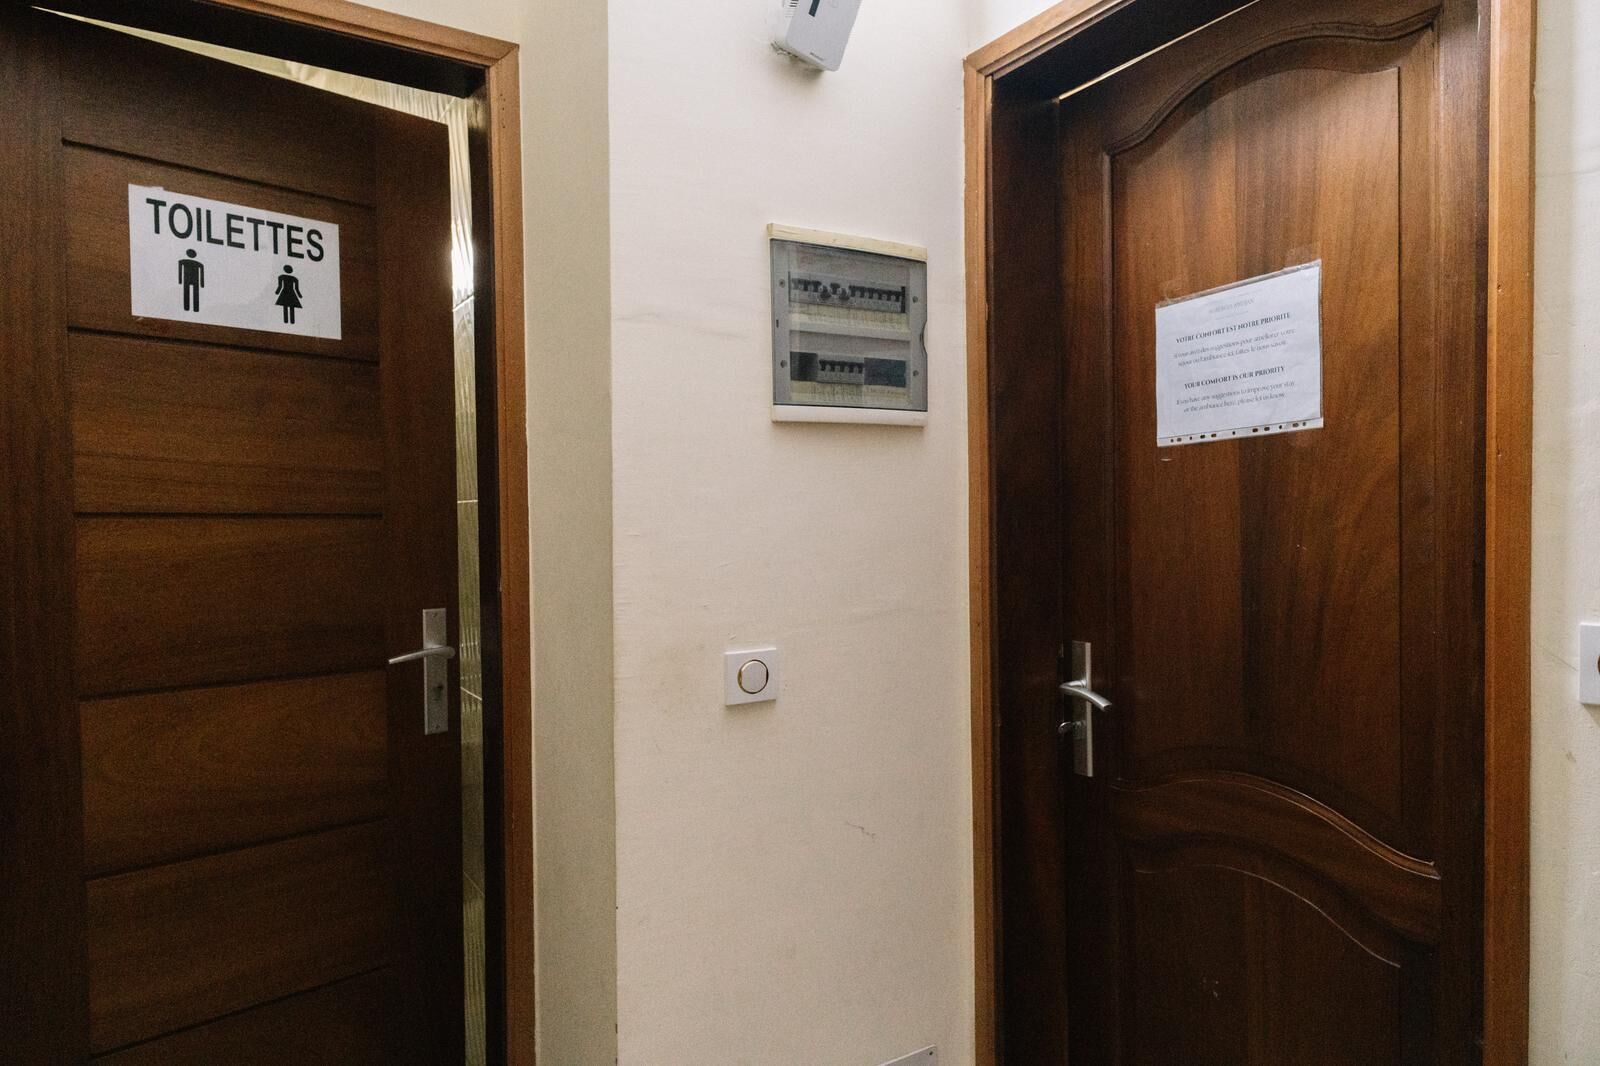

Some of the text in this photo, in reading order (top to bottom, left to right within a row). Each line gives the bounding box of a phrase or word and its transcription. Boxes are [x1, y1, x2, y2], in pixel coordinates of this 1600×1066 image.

[146, 198, 324, 262] TOILETTES
[1176, 335, 1194, 344] VOTRE
[1201, 376, 1231, 386] COMFORT
[1255, 366, 1284, 377] PRIORITY
